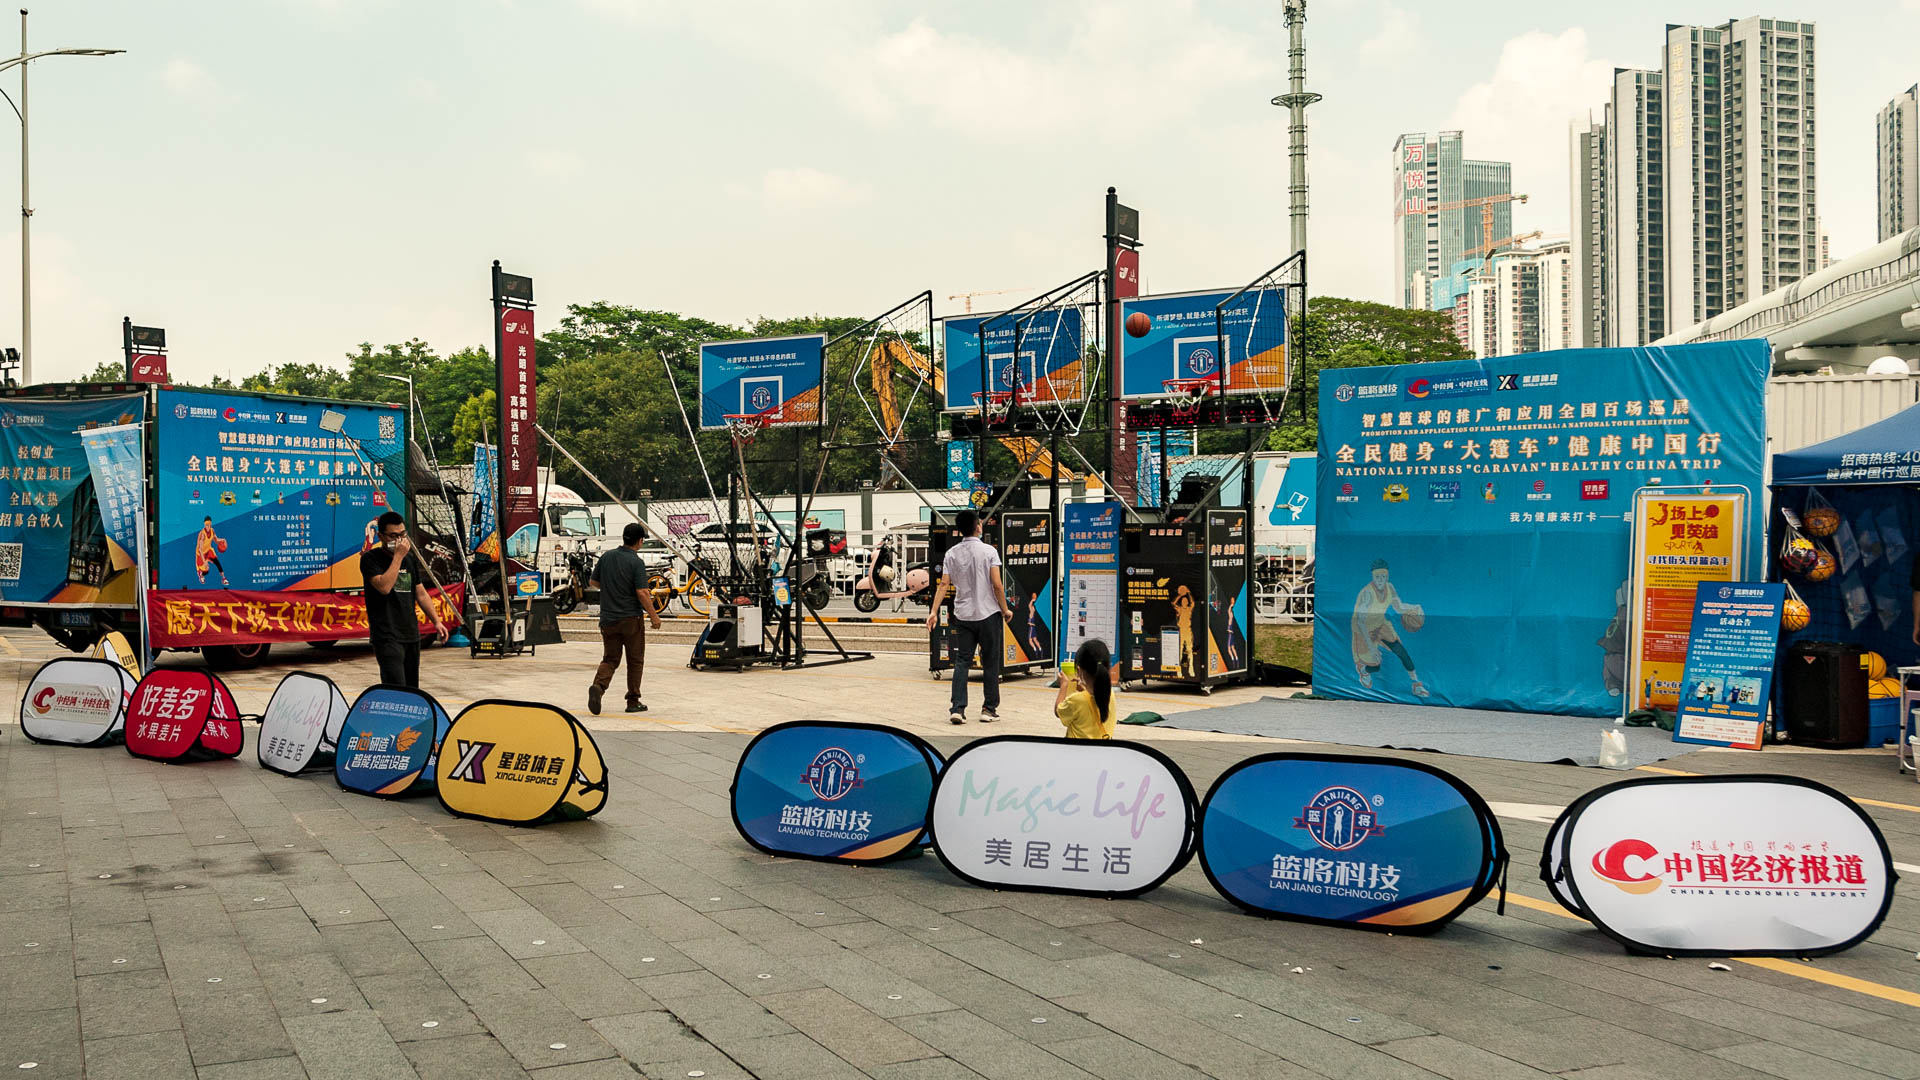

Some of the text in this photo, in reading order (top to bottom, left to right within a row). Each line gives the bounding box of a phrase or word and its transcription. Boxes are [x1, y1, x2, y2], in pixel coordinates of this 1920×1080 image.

[1404, 145, 1425, 215] 万悦山
[1362, 398, 1689, 429] 智慧篮球的推广和应用全国百场巡展
[18, 444, 54, 460] 轻创业
[1336, 466, 1403, 477] NATIONAL
[1406, 464, 1462, 475] FITNESS
[1550, 460, 1622, 472] HEALTHY
[1625, 459, 1677, 470] CHINA
[1680, 458, 1722, 469] TRIP
[187, 474, 231, 484] NATIONAL
[232, 475, 265, 484] FITNESS
[9, 491, 58, 507] 全国火热
[0, 513, 64, 528] 招募合伙人
[1669, 505, 1703, 521] 场上
[1669, 523, 1718, 540] 见英雄
[138, 684, 196, 721] 好麦多
[136, 721, 183, 743] 水果麦片
[351, 753, 411, 771] 智能投篮设备
[497, 750, 566, 776] 星路体育
[818, 751, 850, 767] LANJIANG
[494, 771, 524, 783] XINGLU
[958, 768, 1166, 841] Magic Life
[1317, 790, 1363, 811] LANJIANG
[780, 804, 873, 833] 篮将科技
[778, 825, 869, 841] LAN JIANG TECHNOLOGY
[984, 837, 1132, 875] 美居生活
[1270, 853, 1402, 892] 篮将科技
[1663, 852, 1868, 885] 中国经济报道
[1269, 879, 1398, 903] LAN JIANG TECHNOLOGY
[1725, 889, 1801, 897] ECONOMIC
